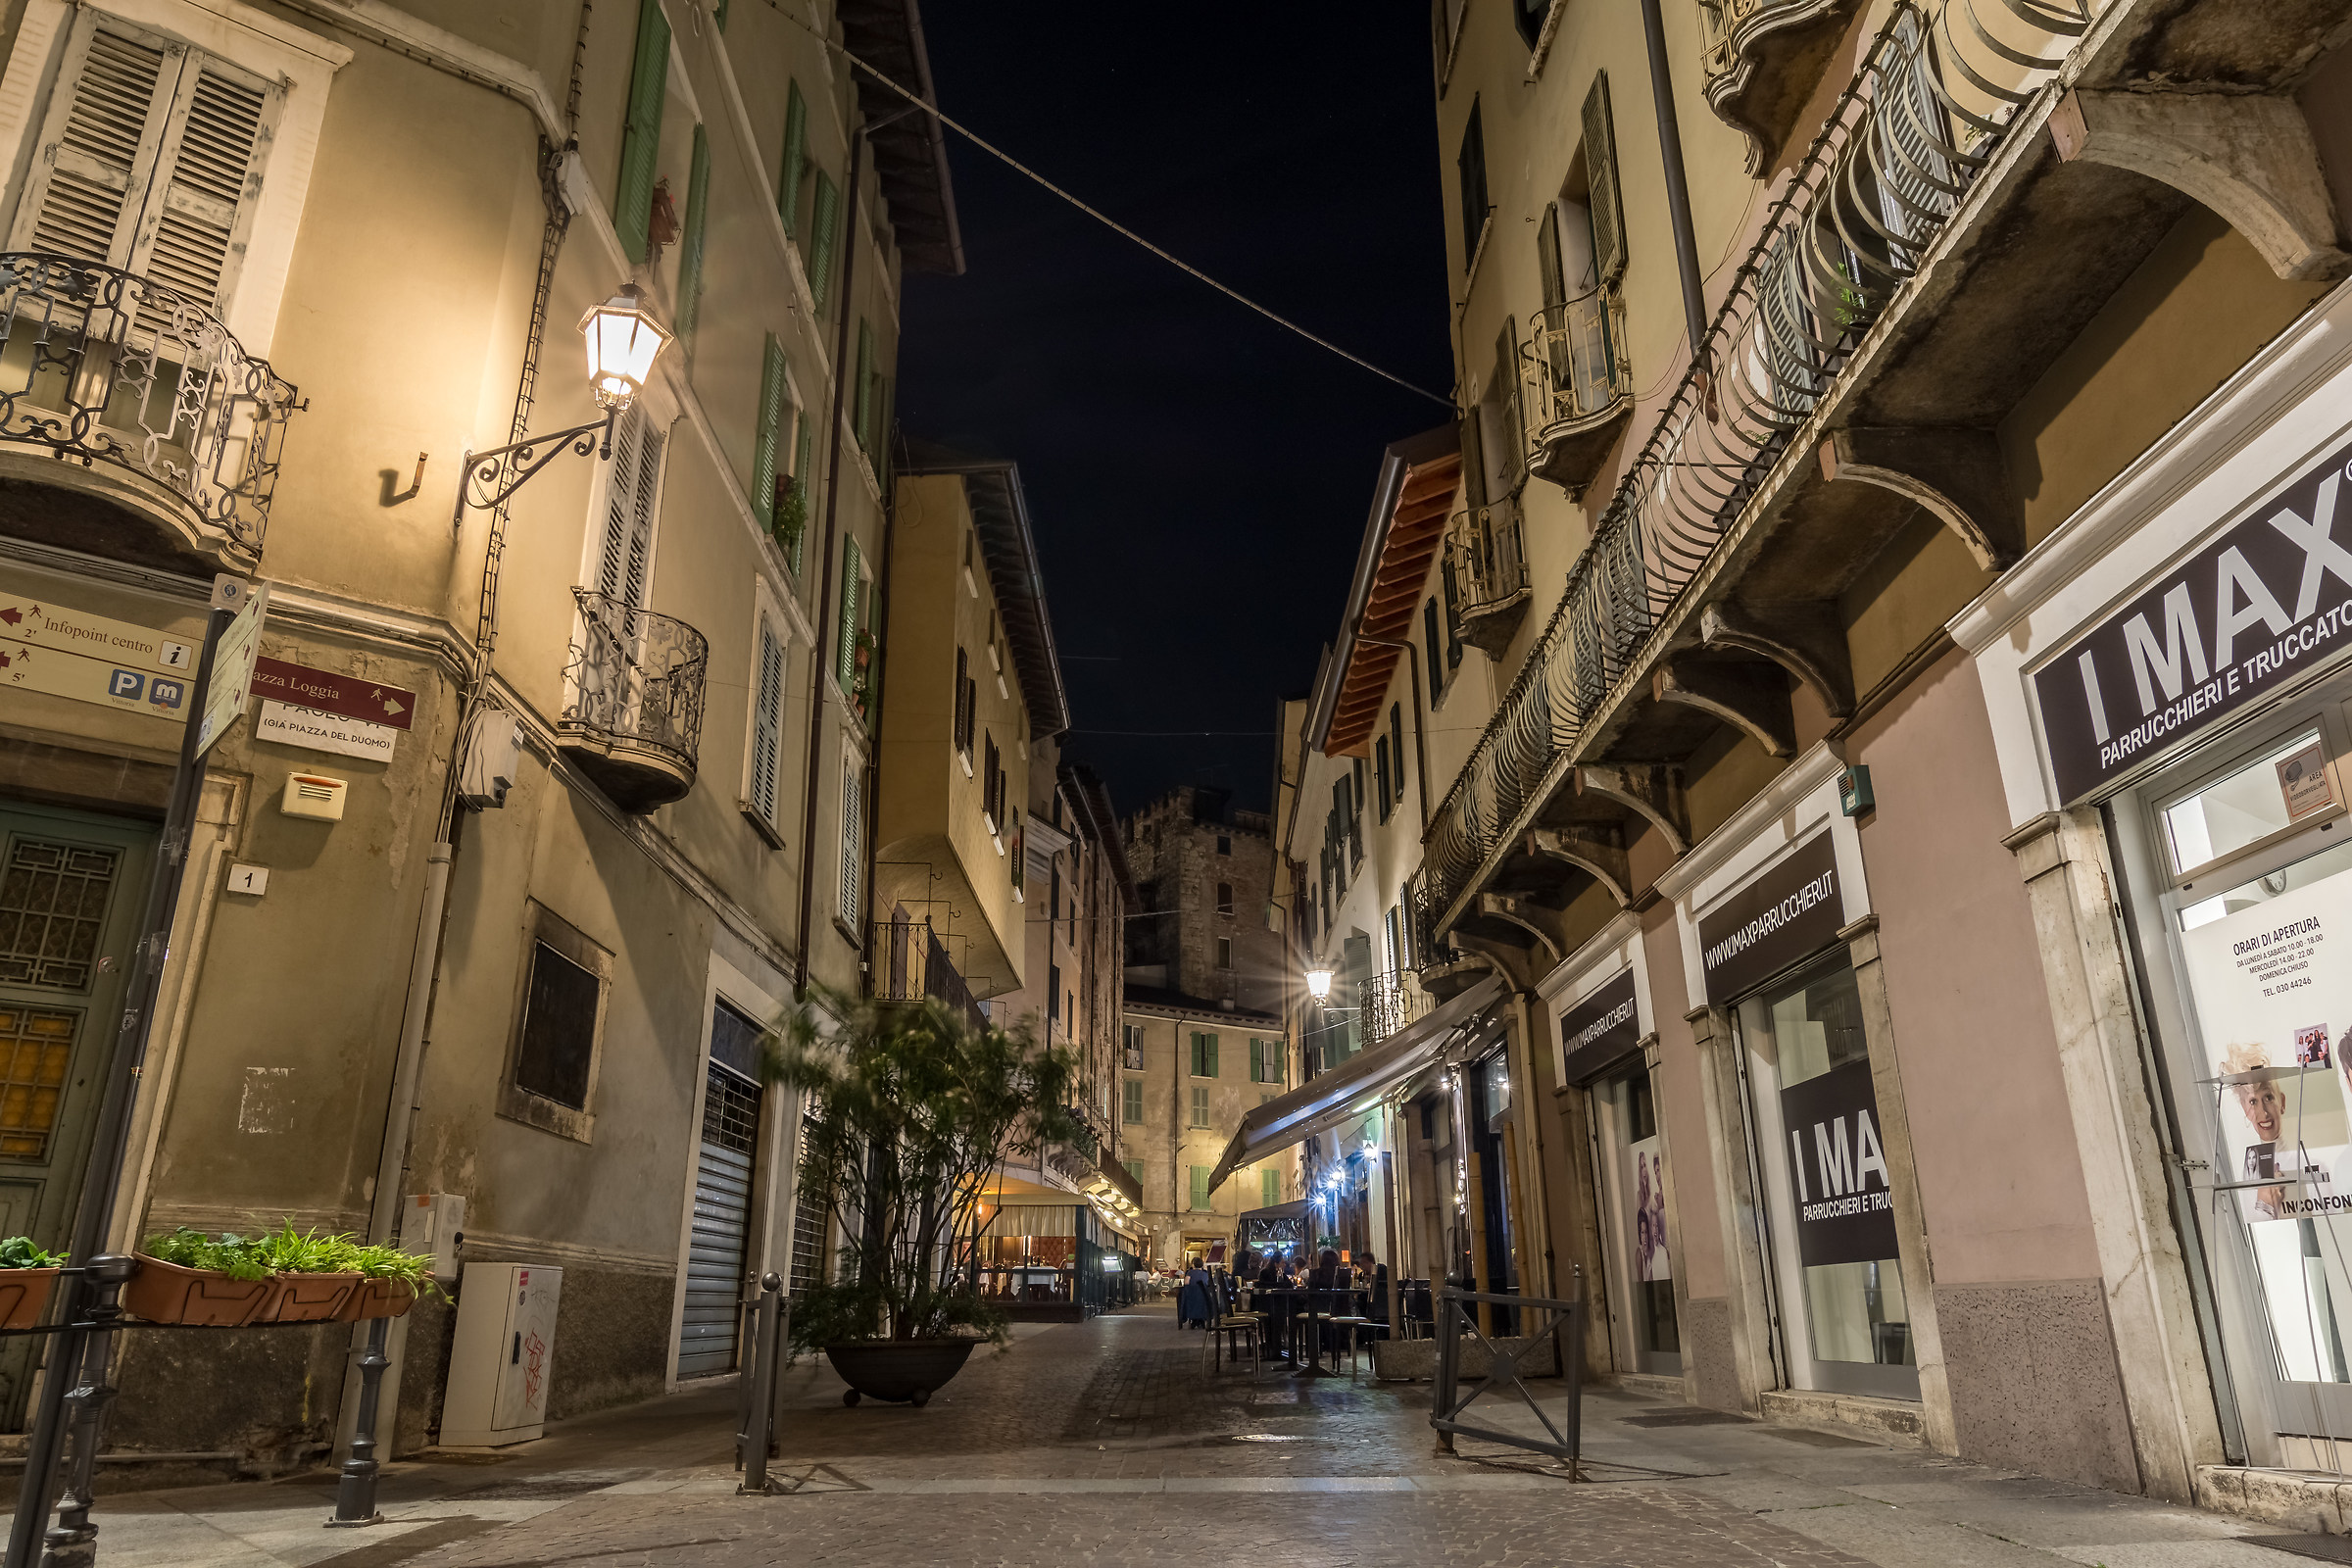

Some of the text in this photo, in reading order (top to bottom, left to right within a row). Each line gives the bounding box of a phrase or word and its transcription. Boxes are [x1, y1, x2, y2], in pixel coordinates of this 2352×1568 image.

[2079, 468, 2352, 745] I MAX
[44, 617, 108, 643] Infopoint
[112, 636, 153, 654] centro
[290, 677, 340, 700] Loggia
[2100, 678, 2223, 769] PARRUCCHIERI
[2227, 668, 2240, 696] E
[289, 723, 327, 737] PIAZZA
[331, 731, 349, 741] DEL
[351, 735, 390, 749] DUOMO)
[2309, 770, 2323, 782] AREA
[245, 872, 253, 888] 1
[1705, 869, 1833, 971] WWW.IMAXPARRUCCHIERI.IT
[2233, 916, 2321, 956] ORARI DI APERTURA
[2236, 959, 2244, 968] DA
[2267, 946, 2287, 958] SABATO
[2288, 940, 2304, 952] 10.00
[2307, 934, 2324, 945] 18.00
[2278, 954, 2295, 965] 14.00
[2298, 948, 2315, 959] 22.00
[2259, 960, 2309, 982] DOMENICA CHIUSO
[2263, 976, 2312, 998] TEL. 030 44246
[1792, 1108, 1889, 1202] I MA
[1803, 1196, 1861, 1222] PARRUCCHIERI
[1862, 1195, 1869, 1213] E
[2281, 1195, 2352, 1214] INCONFON
